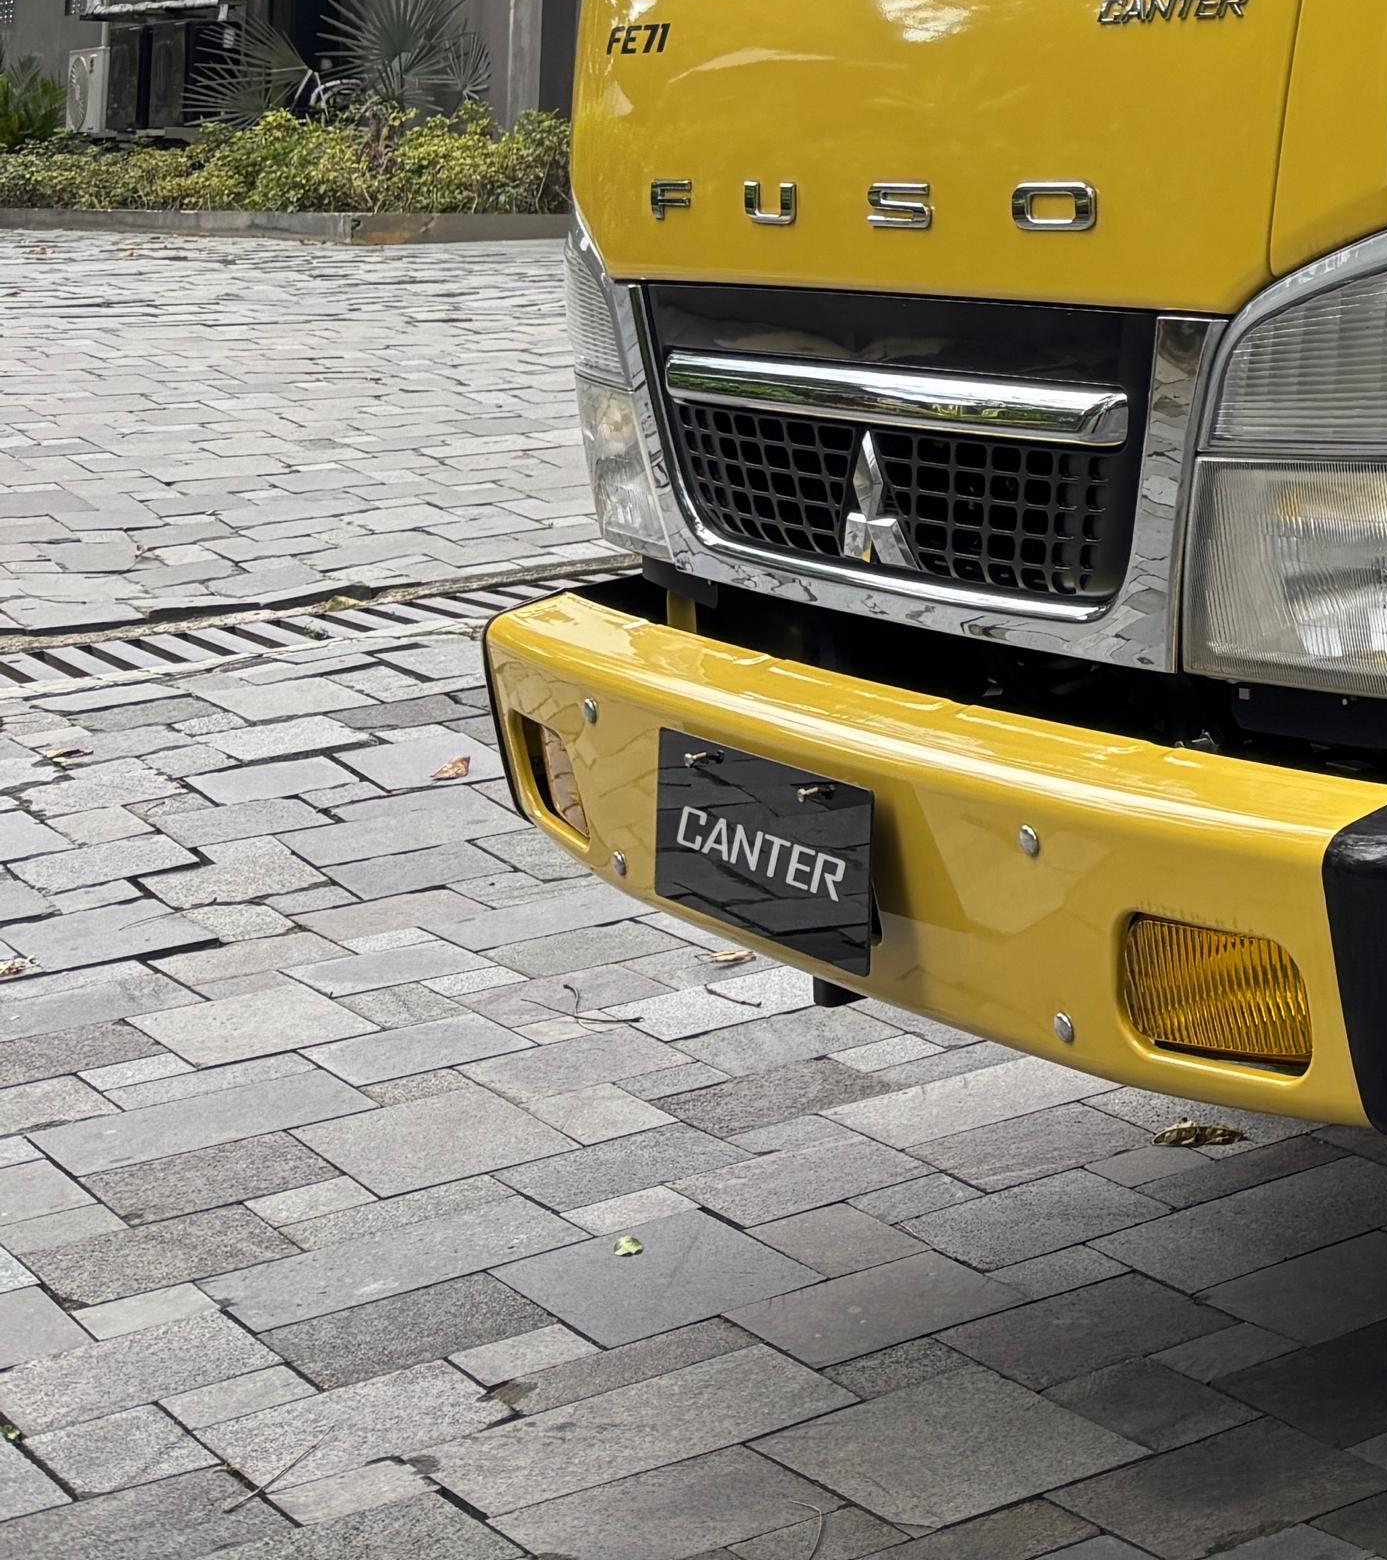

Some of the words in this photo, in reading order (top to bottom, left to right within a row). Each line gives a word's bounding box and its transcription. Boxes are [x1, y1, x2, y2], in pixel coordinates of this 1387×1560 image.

[606, 23, 671, 55] FE71
[650, 178, 1098, 232] FUSO
[676, 806, 846, 902] CANTER
